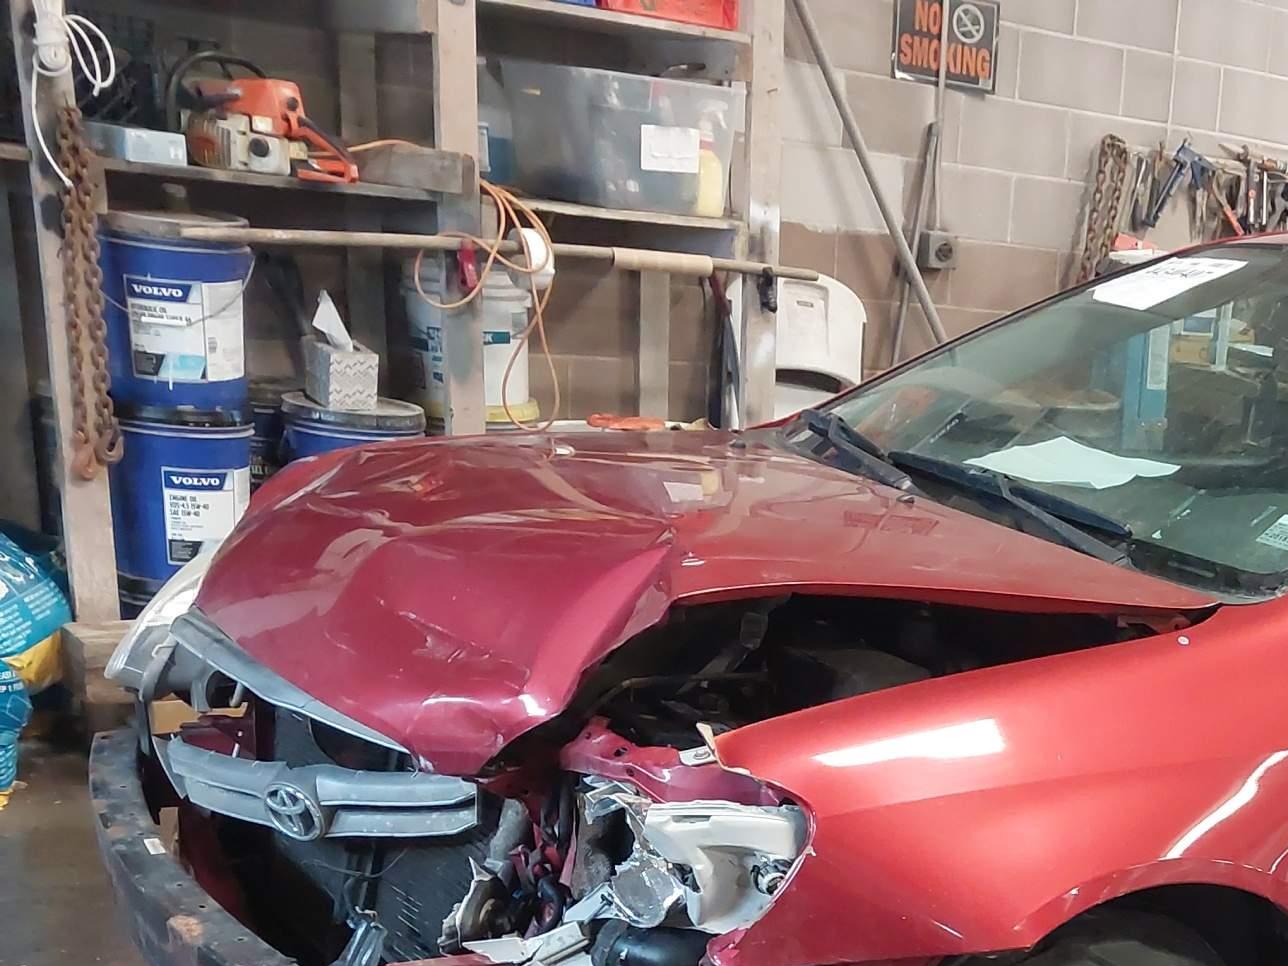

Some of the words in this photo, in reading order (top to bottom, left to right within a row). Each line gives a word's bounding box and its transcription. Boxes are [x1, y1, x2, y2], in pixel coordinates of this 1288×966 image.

[915, 0, 942, 34] NO
[899, 33, 989, 79] SMOKING
[131, 284, 183, 297] VOLVO
[169, 476, 220, 486] VOLVO
